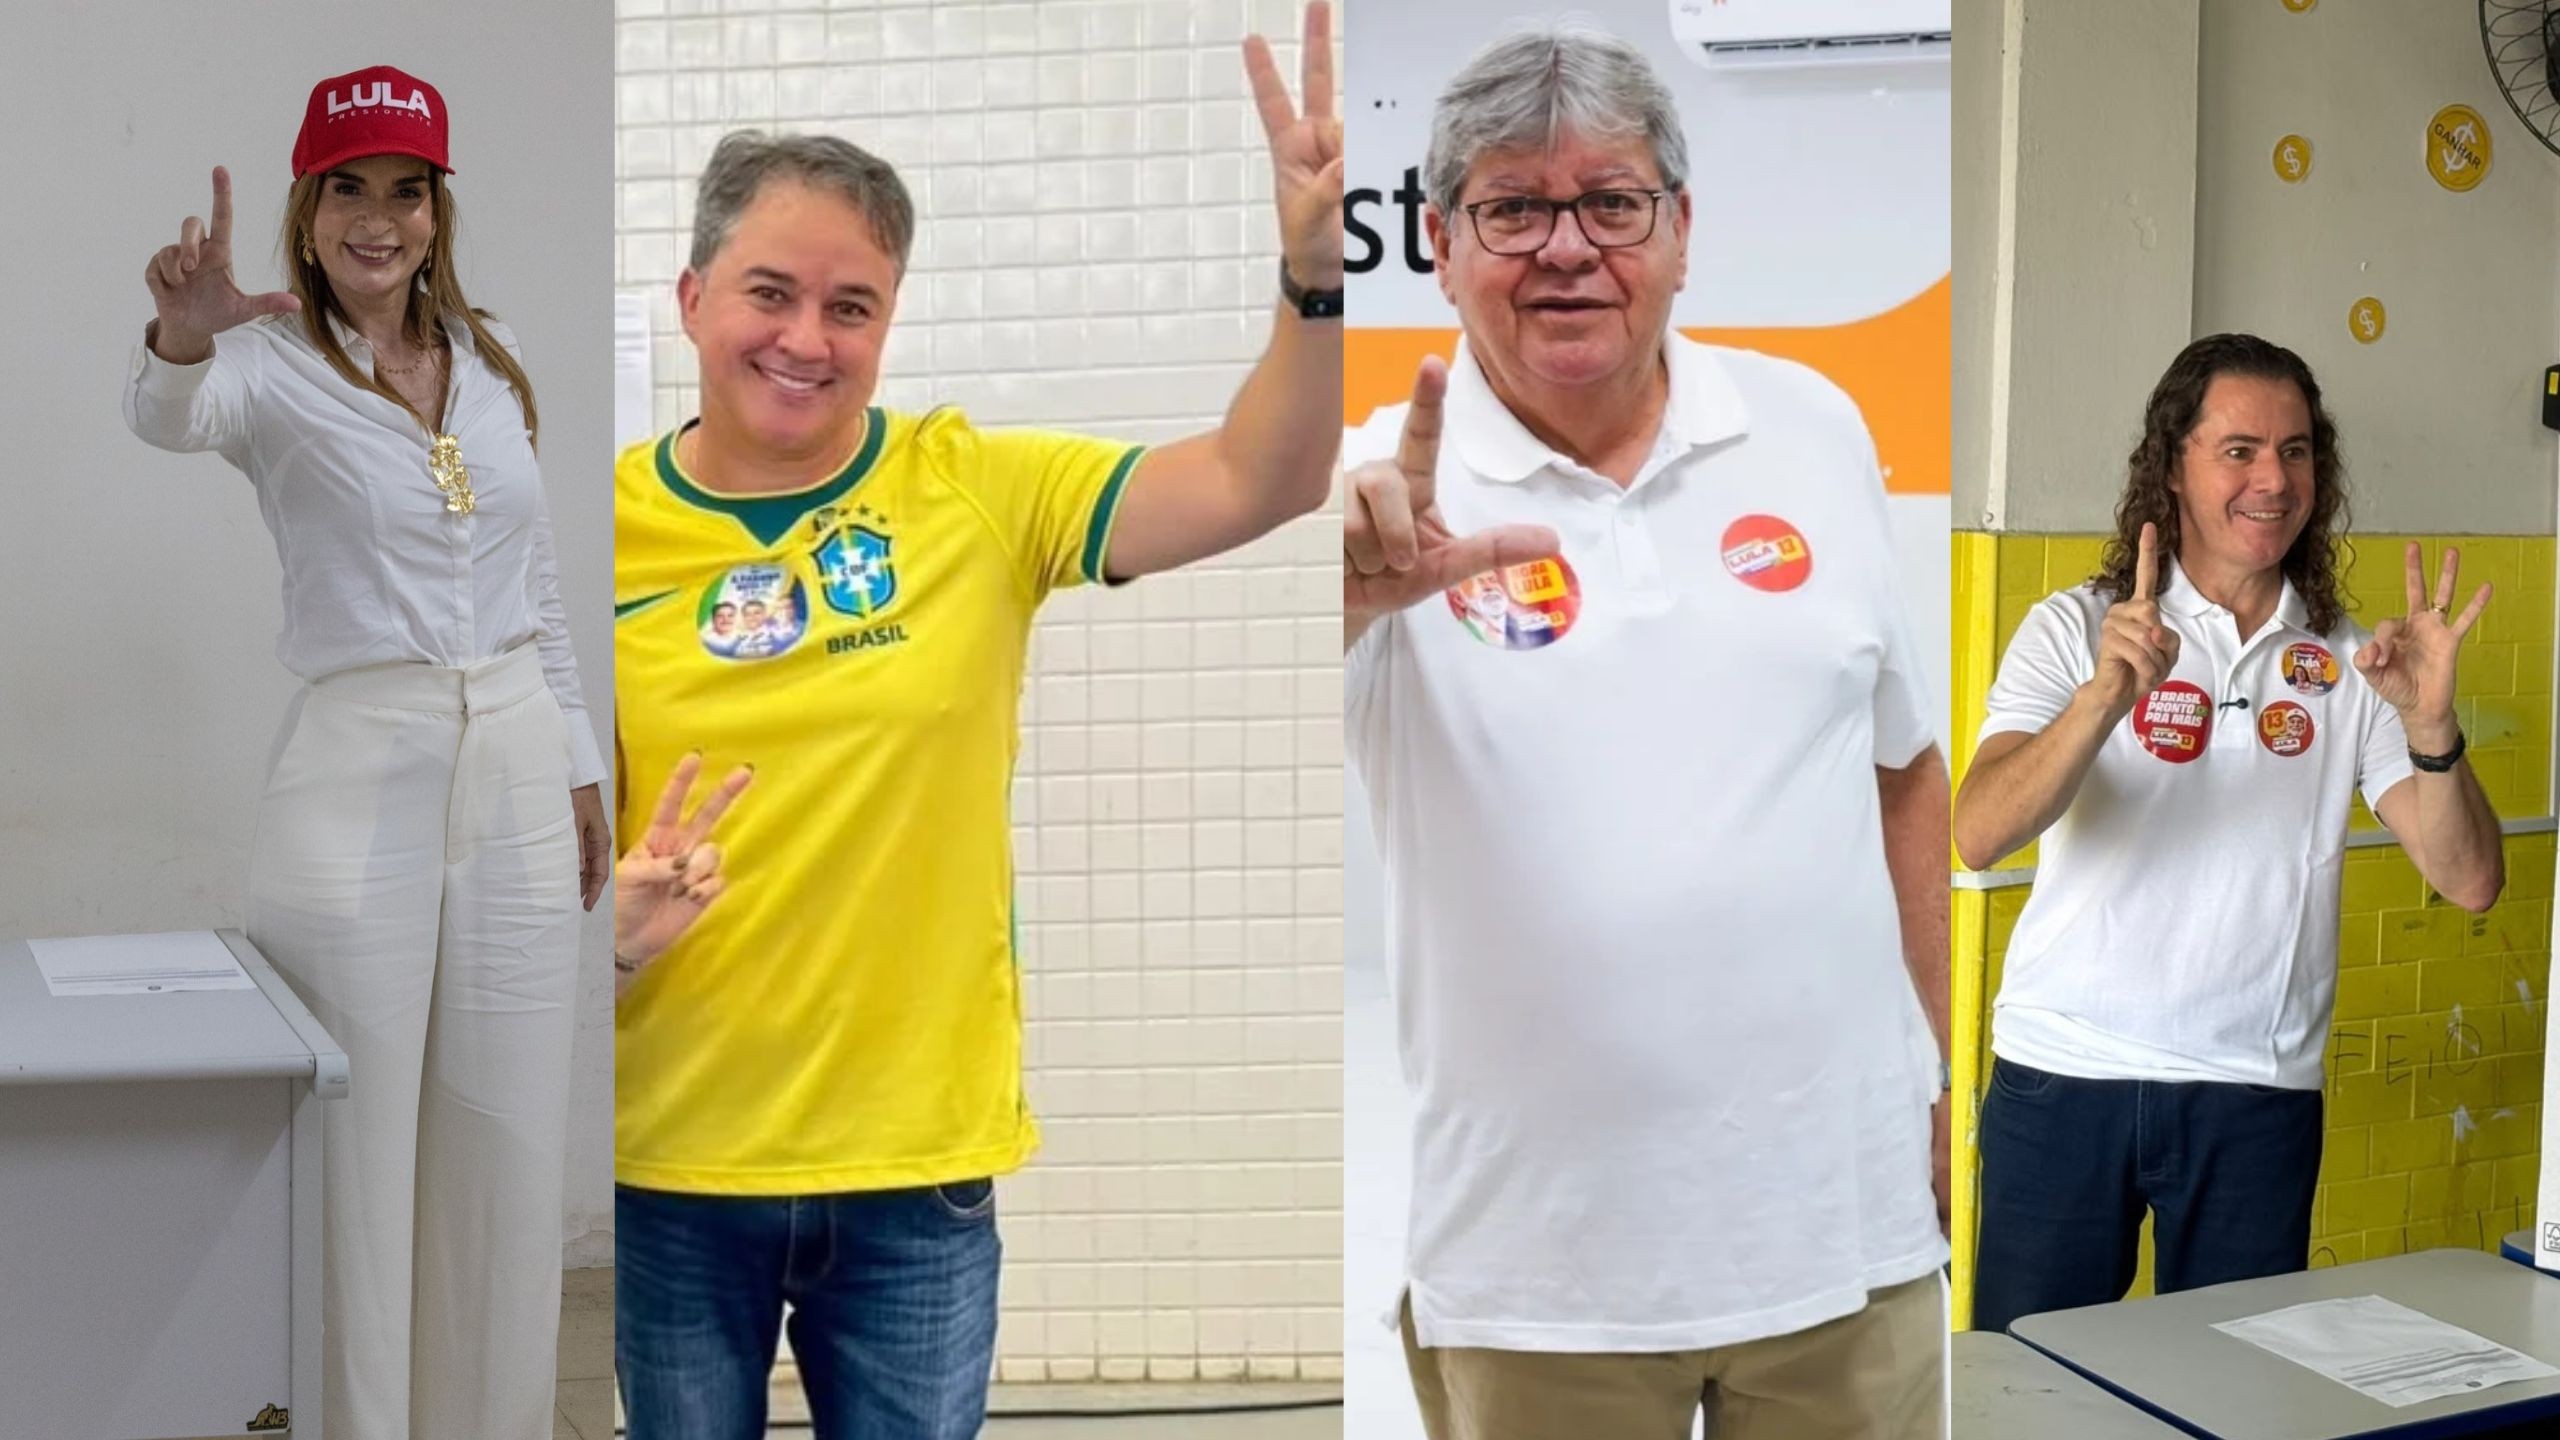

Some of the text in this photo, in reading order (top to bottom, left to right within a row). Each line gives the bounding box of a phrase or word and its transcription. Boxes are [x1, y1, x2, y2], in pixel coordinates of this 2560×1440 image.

[327, 81, 432, 120] LULA
[327, 108, 431, 127] PRESIDENTE
[2434, 123, 2481, 170] GANHAR
[1729, 545, 1774, 567] LULA
[1777, 537, 1796, 555] 13
[826, 623, 909, 654] BRASIL
[2149, 690, 2201, 704] O BRASIL
[2147, 701, 2195, 714] PRONTO
[2144, 711, 2203, 727] PRA MAIS
[2265, 711, 2283, 729] 13
